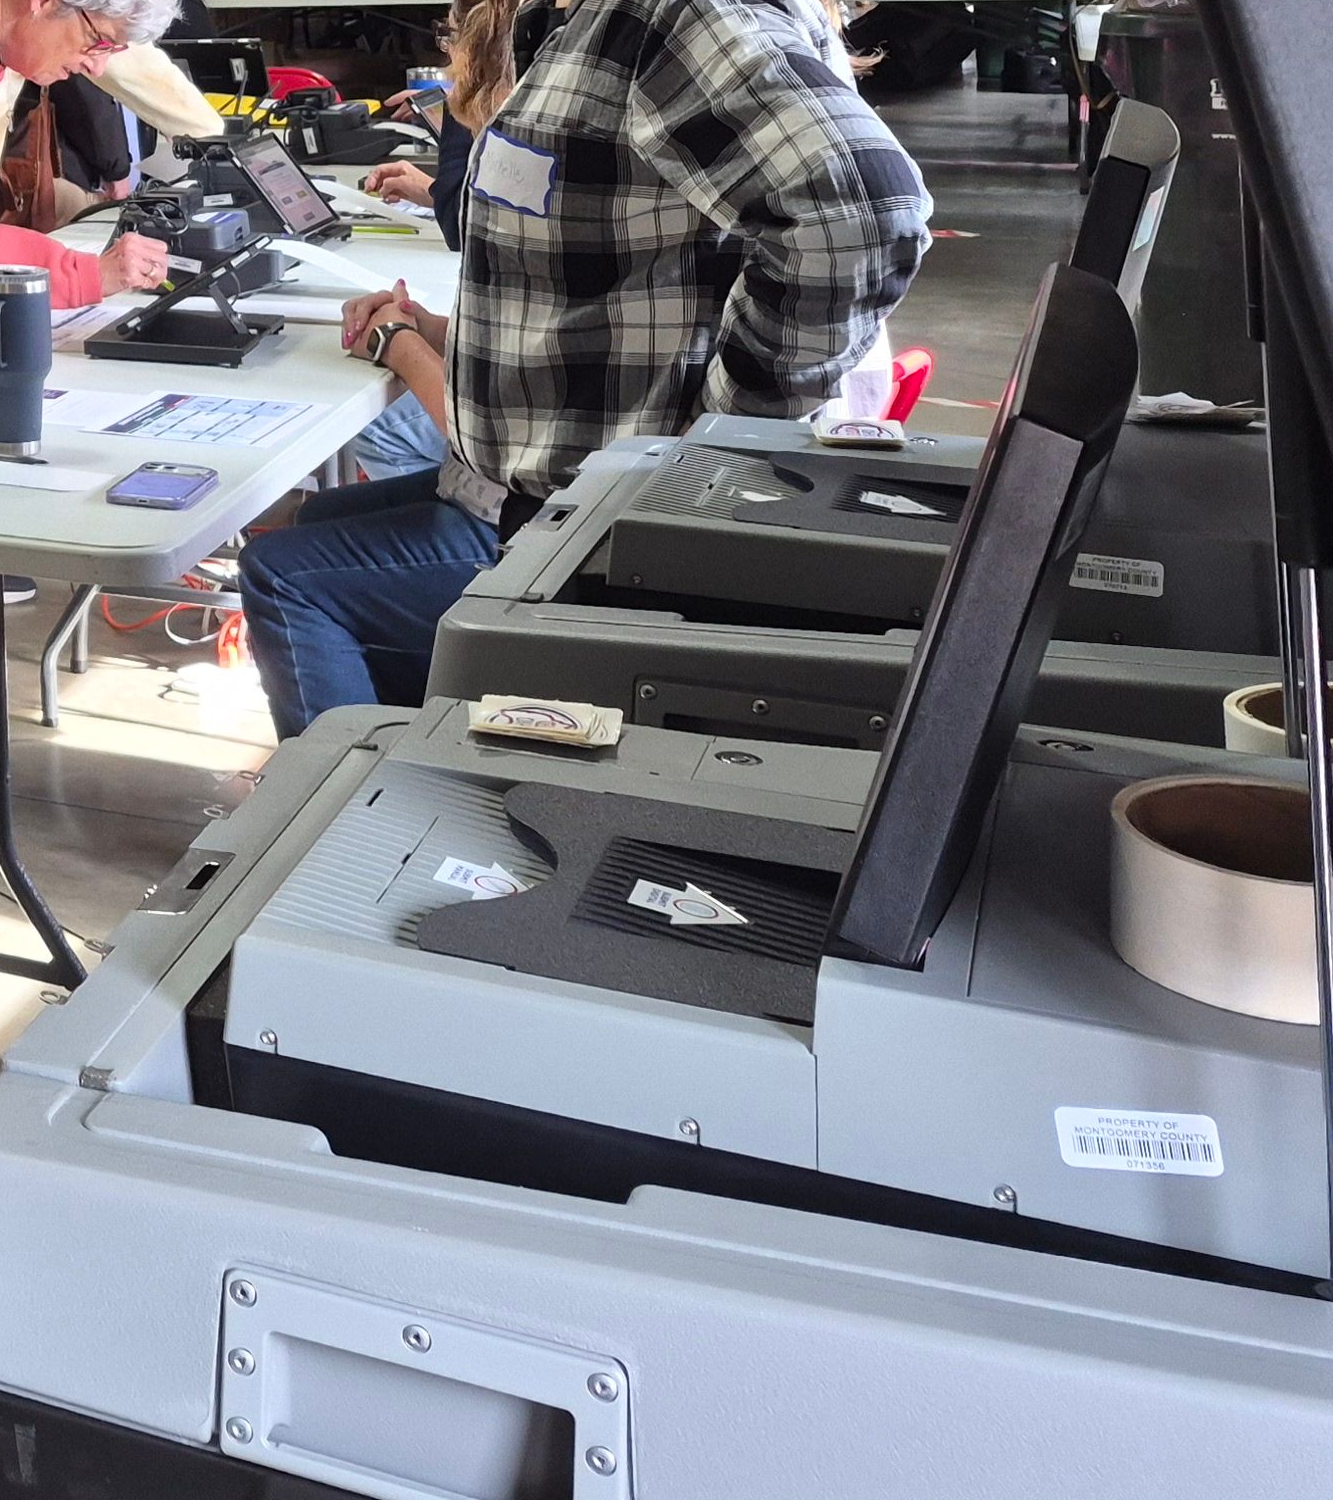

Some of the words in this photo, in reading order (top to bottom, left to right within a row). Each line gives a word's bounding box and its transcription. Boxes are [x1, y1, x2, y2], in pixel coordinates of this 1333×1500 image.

[1098, 1116, 1160, 1130] PROPERTY
[1163, 1121, 1179, 1130] OF
[1074, 1126, 1157, 1140] MONTGOMERY
[1160, 1131, 1209, 1143] COUNTY
